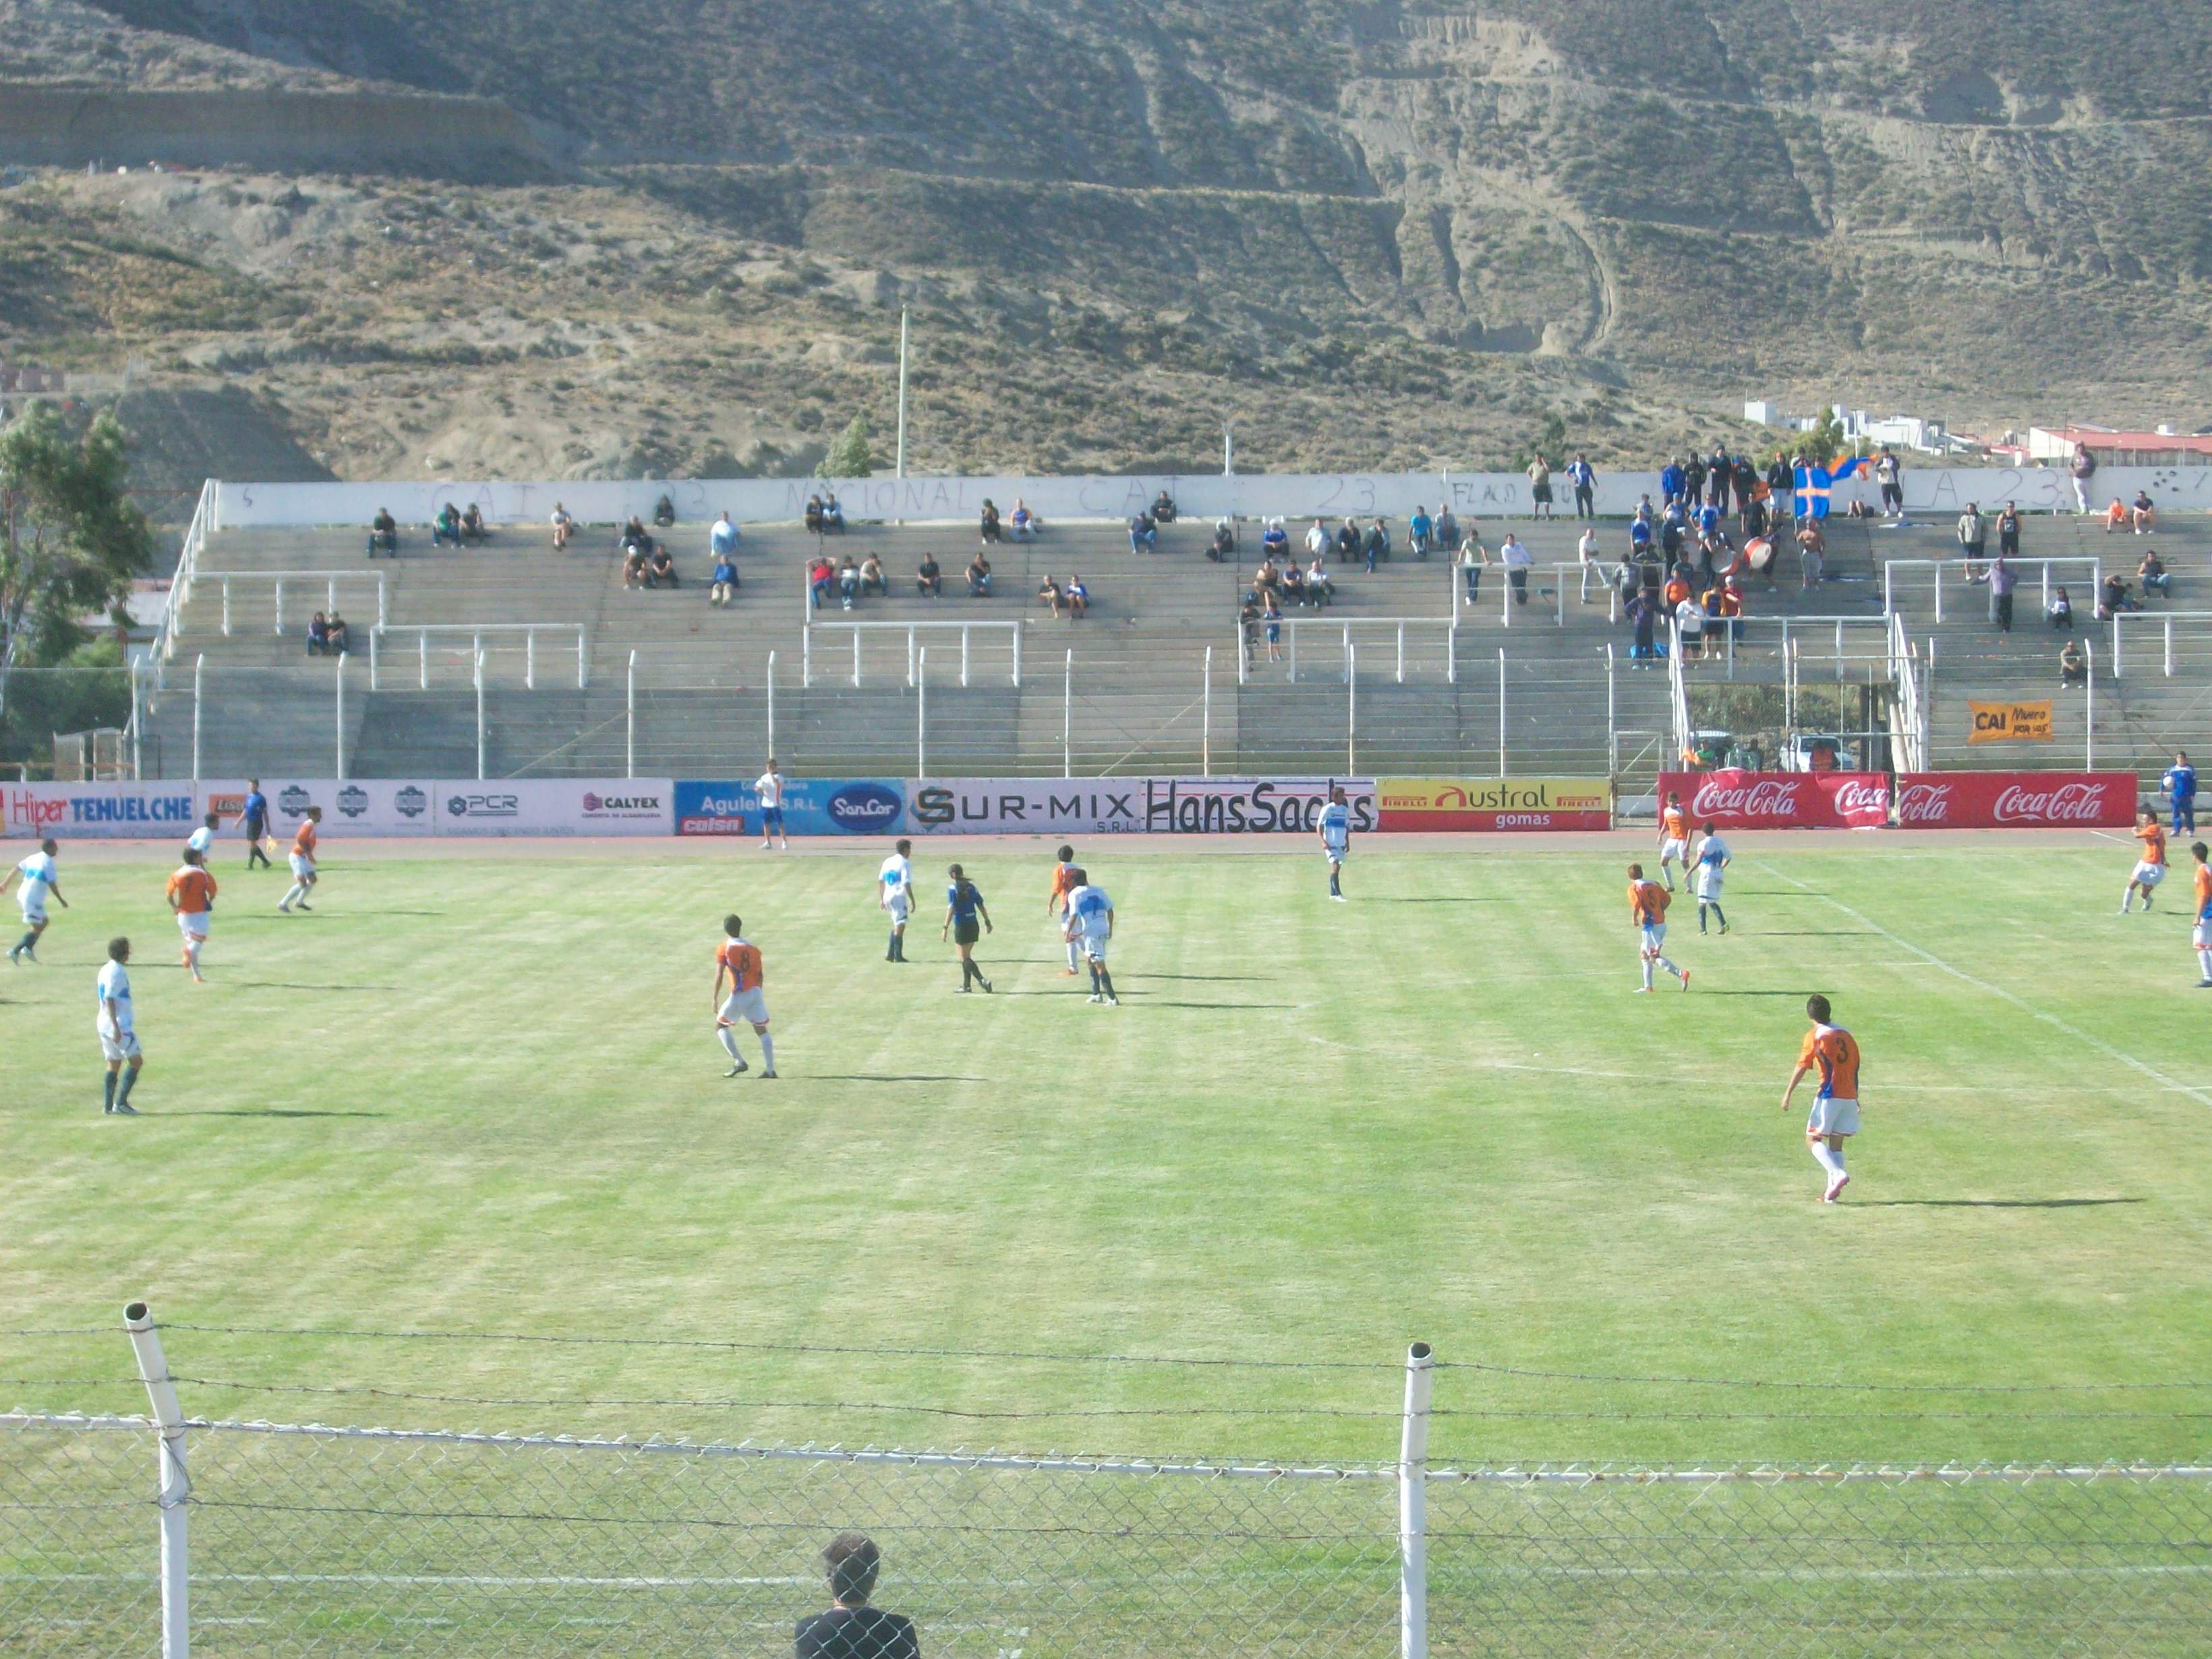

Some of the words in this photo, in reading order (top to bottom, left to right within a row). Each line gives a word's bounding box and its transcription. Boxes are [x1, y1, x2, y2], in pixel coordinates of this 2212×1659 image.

[1316, 475, 1376, 513] 23
[1993, 468, 2061, 507] 23
[1975, 711, 2007, 730] CAI
[467, 794, 519, 809] PCR
[604, 796, 660, 809] CALTEX
[834, 796, 896, 816] SanCor
[1382, 795, 1428, 807] PIRELLI
[1691, 780, 1801, 819] Coca-Cola
[1993, 782, 2108, 822] Coca-Cola
[13, 789, 67, 838] Hiper
[70, 796, 193, 822] TEHUELCHE
[1495, 813, 1550, 830] gomas
[1835, 1037, 1849, 1064] 3
